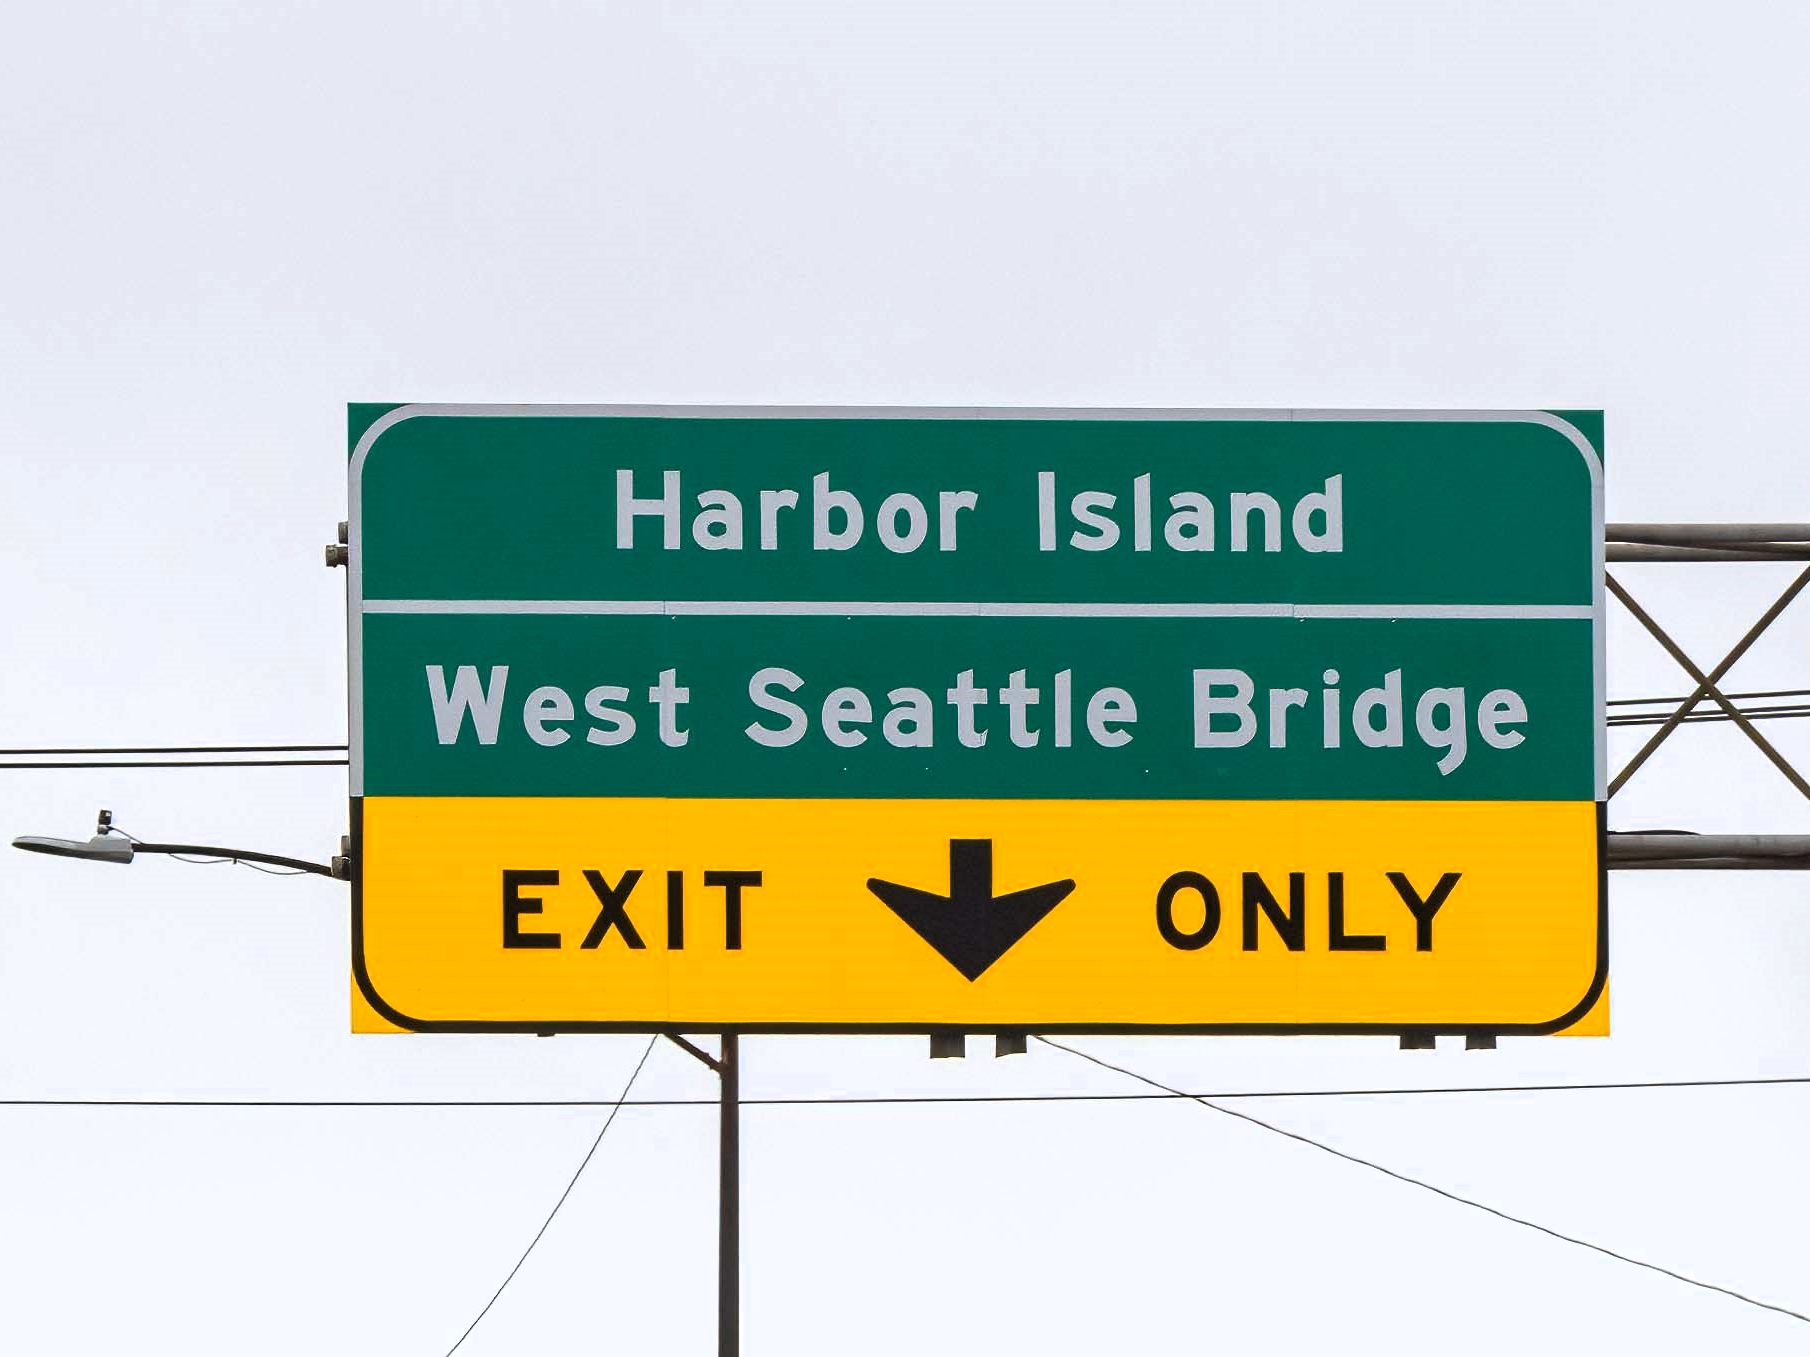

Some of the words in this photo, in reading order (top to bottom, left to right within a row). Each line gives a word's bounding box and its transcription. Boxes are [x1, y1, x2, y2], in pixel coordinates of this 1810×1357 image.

[616, 469, 979, 554] Harbor
[1037, 471, 1343, 553] Island
[425, 664, 690, 748] West
[744, 667, 1138, 749] Seattle
[1193, 668, 1528, 776] Bridge
[502, 869, 763, 950] EXIT
[1156, 870, 1463, 952] ONLY
